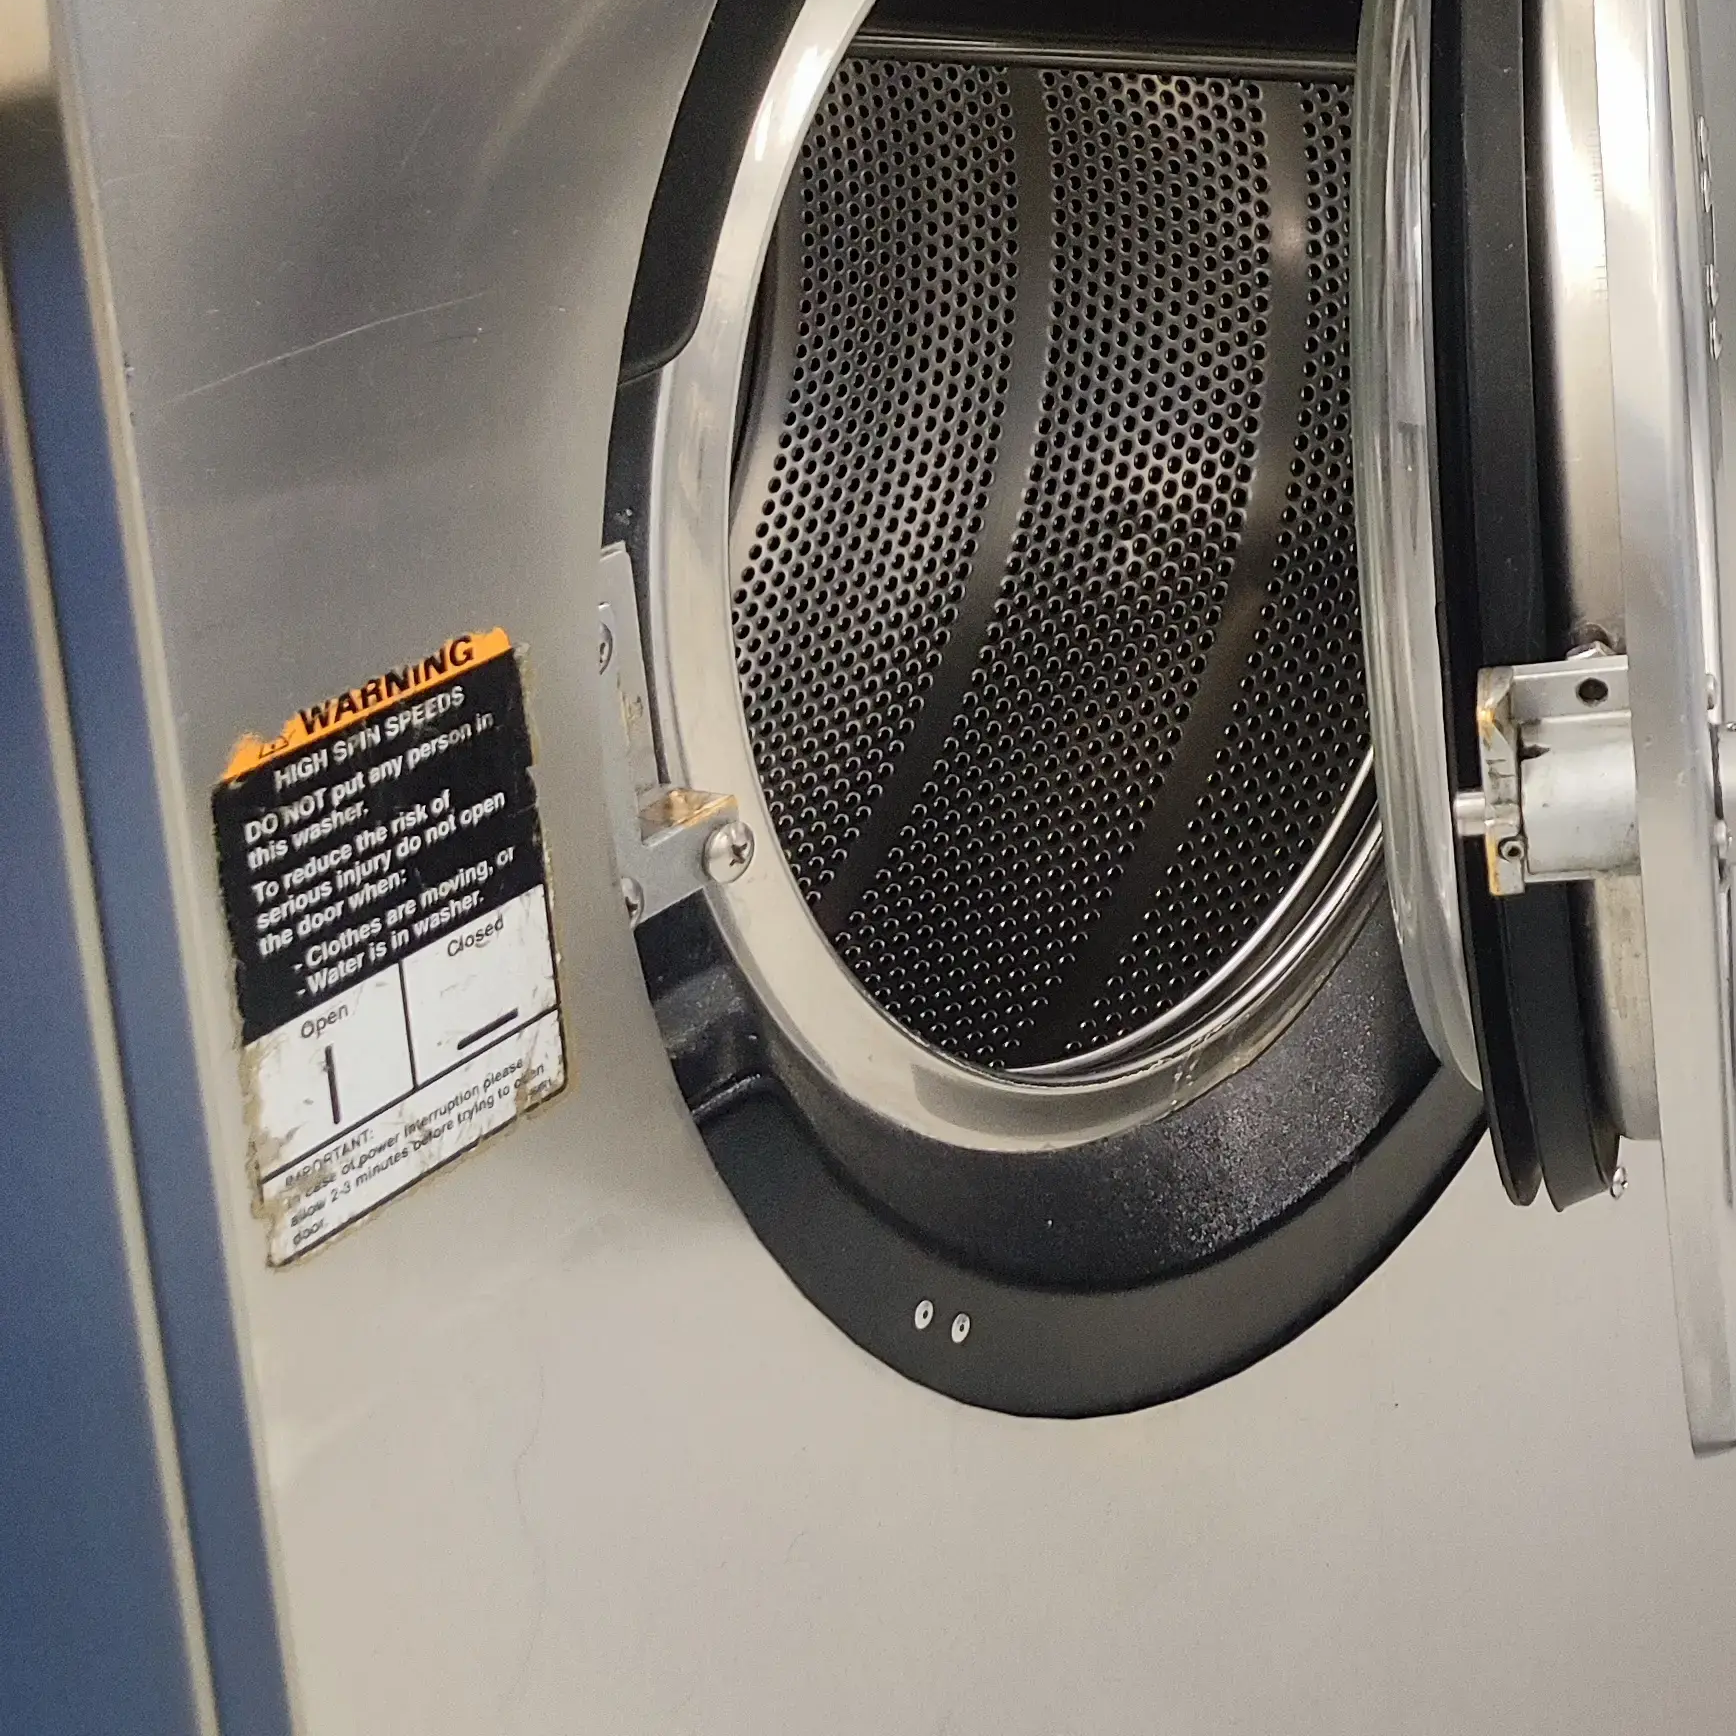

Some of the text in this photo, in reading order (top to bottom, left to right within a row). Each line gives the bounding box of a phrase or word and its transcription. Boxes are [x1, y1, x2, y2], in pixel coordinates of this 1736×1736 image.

[274, 685, 466, 792] HIGH SPIN SPEEDS
[299, 635, 475, 735] WARNING
[244, 712, 495, 844] DO NOT put any person in
[247, 800, 369, 871] this washer.
[252, 788, 450, 905] To reduce the risk of
[257, 791, 506, 930] serious injury do not open
[259, 868, 407, 959] the door when:
[305, 846, 516, 968] Clothes are moving, or
[306, 889, 485, 996] Water is in washer.
[447, 911, 505, 957] Closed
[300, 1004, 349, 1040] Open
[330, 1180, 352, 1204] 2-3
[355, 1146, 410, 1189] minutes
[457, 1094, 496, 1126] trying
[498, 1083, 512, 1100] to
[358, 1131, 401, 1170] power
[404, 1084, 481, 1139] interruption
[483, 1058, 524, 1092] please
